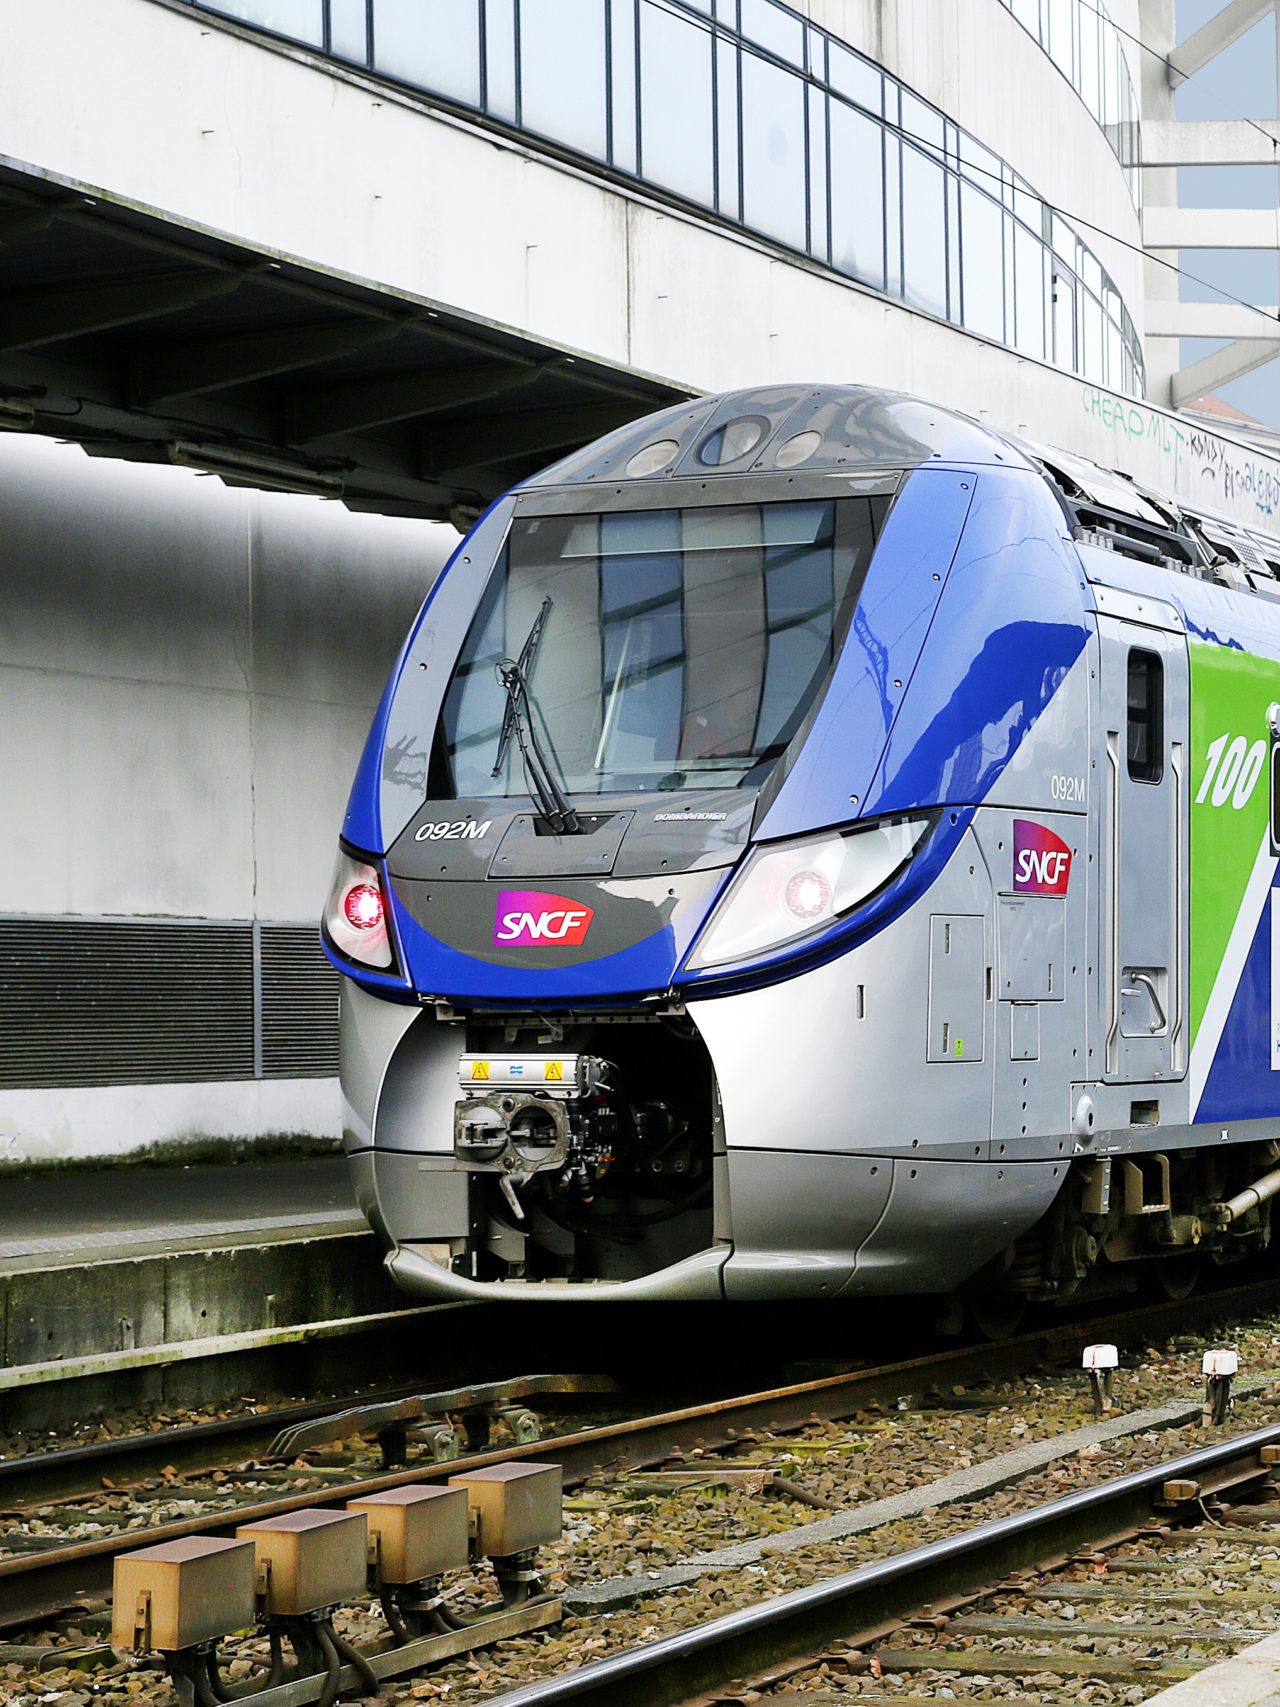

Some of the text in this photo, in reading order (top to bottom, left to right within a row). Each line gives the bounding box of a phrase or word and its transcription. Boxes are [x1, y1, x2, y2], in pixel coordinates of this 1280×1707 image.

[1195, 732, 1267, 810] 100
[1051, 775, 1085, 802] 092M
[414, 819, 493, 842] 092M
[653, 812, 728, 822] BOMBARDIER
[1015, 849, 1069, 885] SNCF
[497, 911, 587, 939] SNCF
